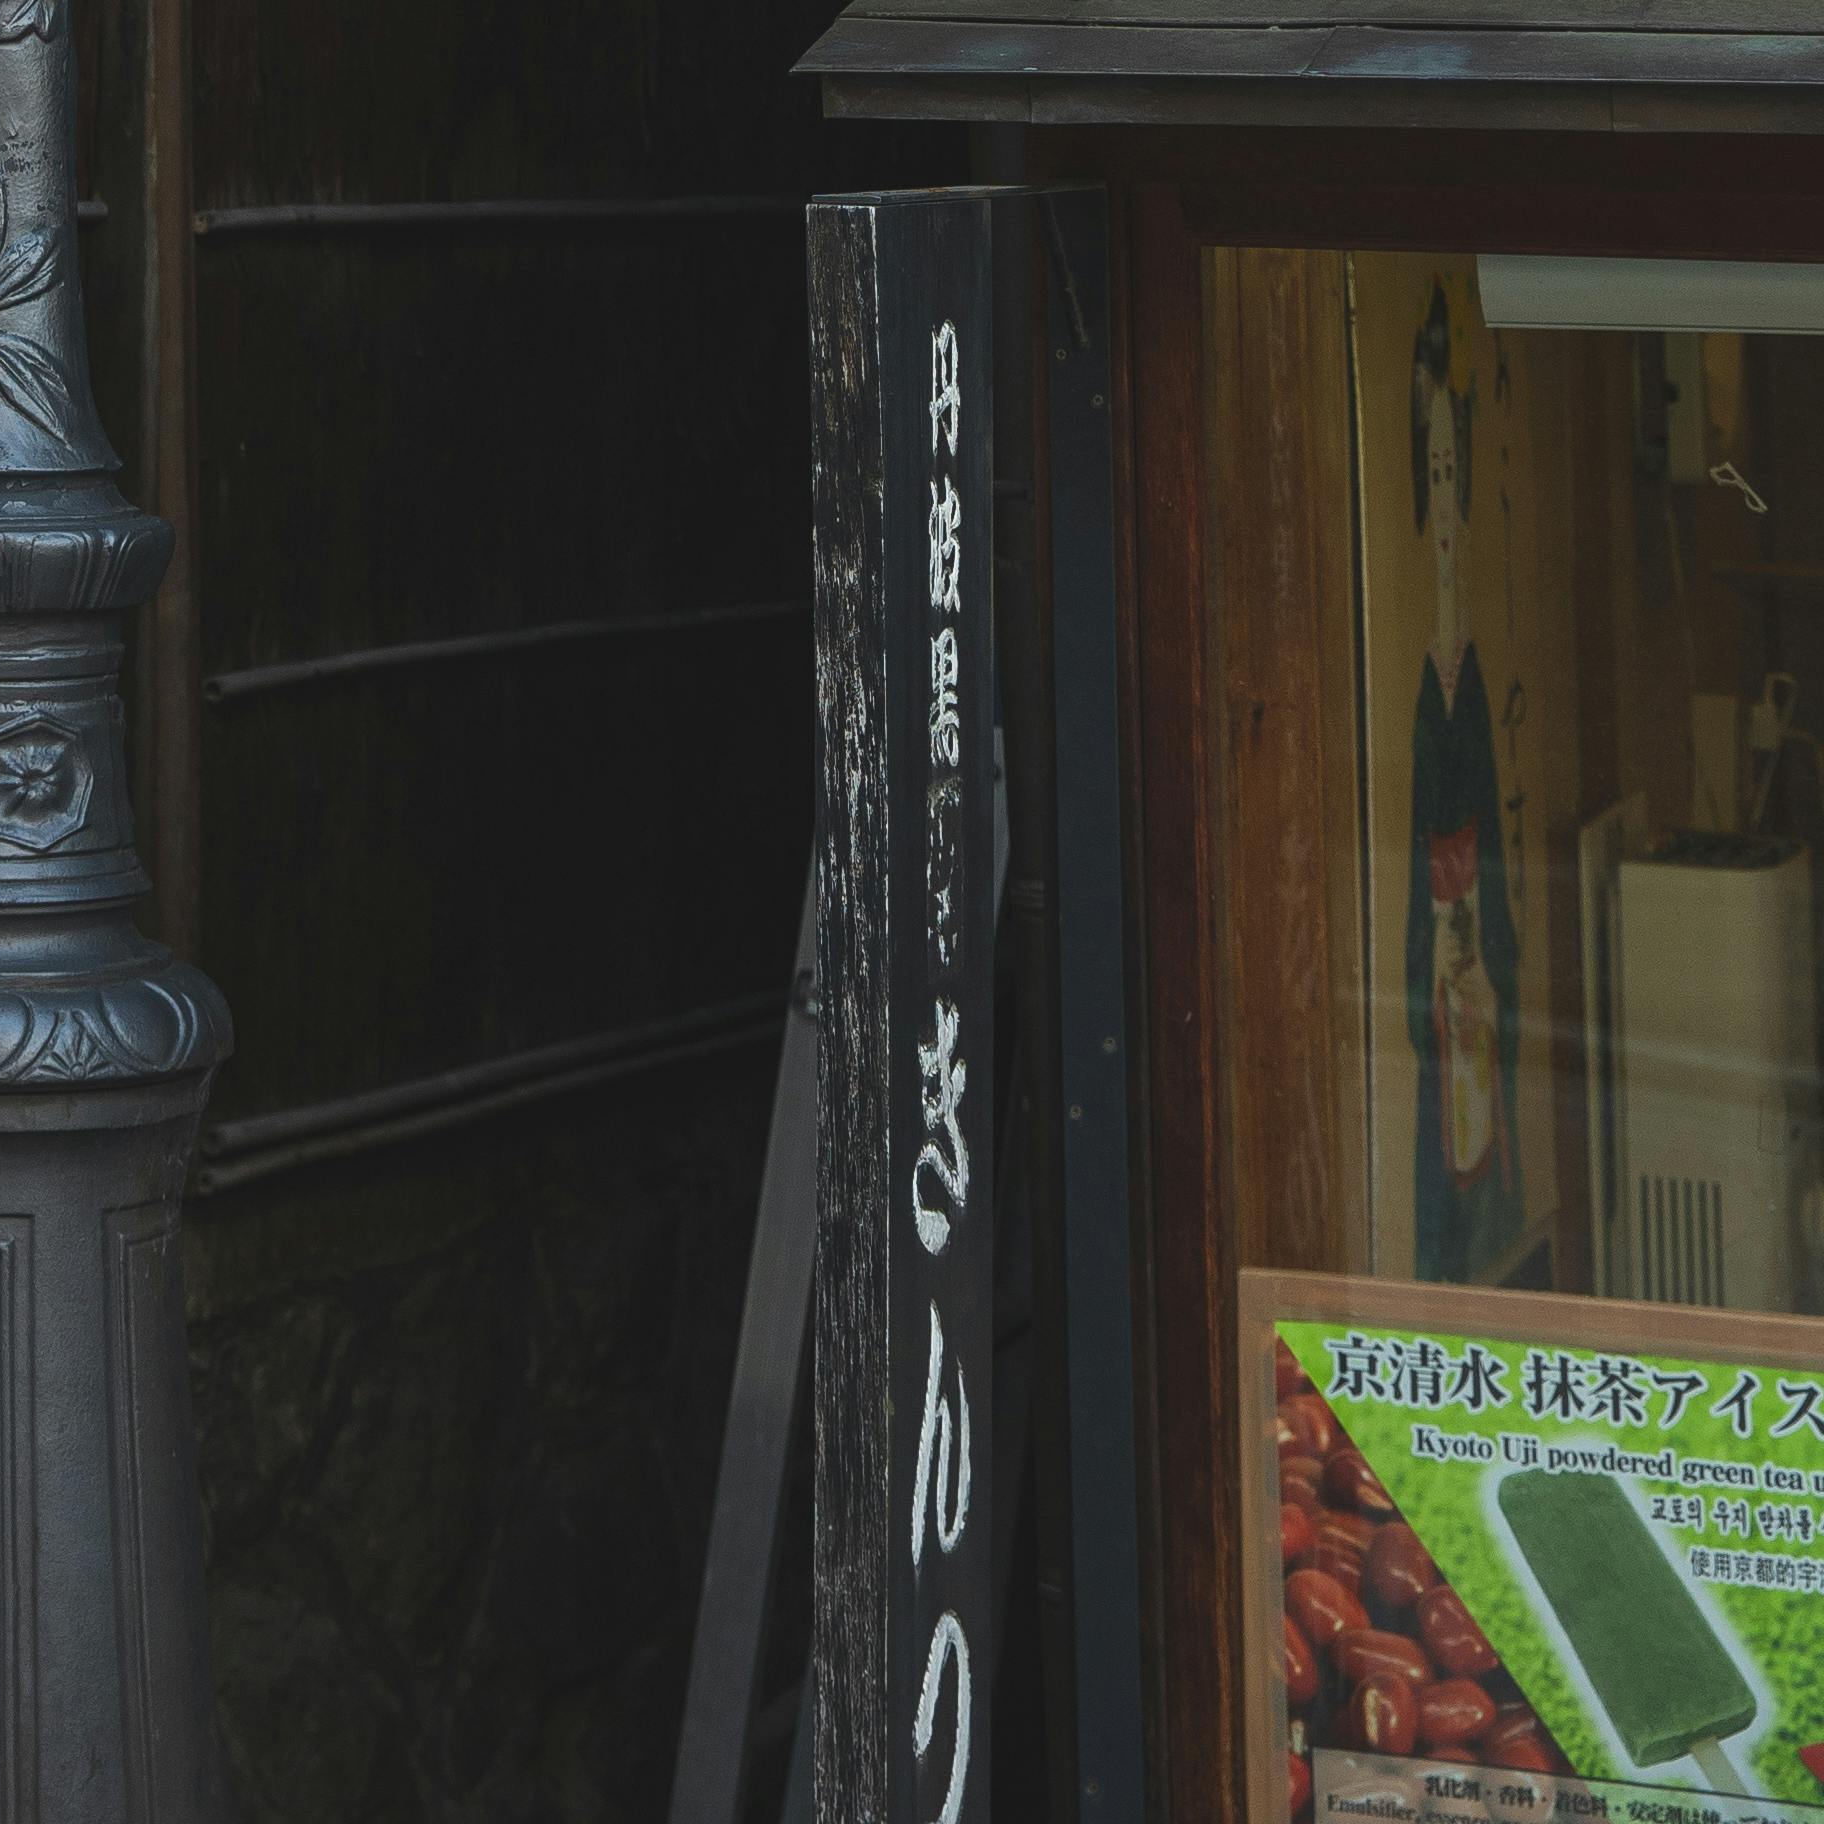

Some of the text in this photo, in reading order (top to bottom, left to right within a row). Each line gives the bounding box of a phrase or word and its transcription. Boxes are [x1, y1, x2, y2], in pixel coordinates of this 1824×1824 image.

[1326, 1336, 1824, 1436] 京清水 抹茶アイス
[1414, 1428, 1492, 1461] Kyoto
[1503, 1438, 1537, 1466] Uji
[1549, 1444, 1672, 1479] powdered
[1683, 1461, 1755, 1486] green
[1764, 1465, 1804, 1491] tea
[1651, 1497, 1703, 1528] 교토의
[1713, 1500, 1748, 1536] 우지
[1690, 1548, 1824, 1589] 使用京都的宇
